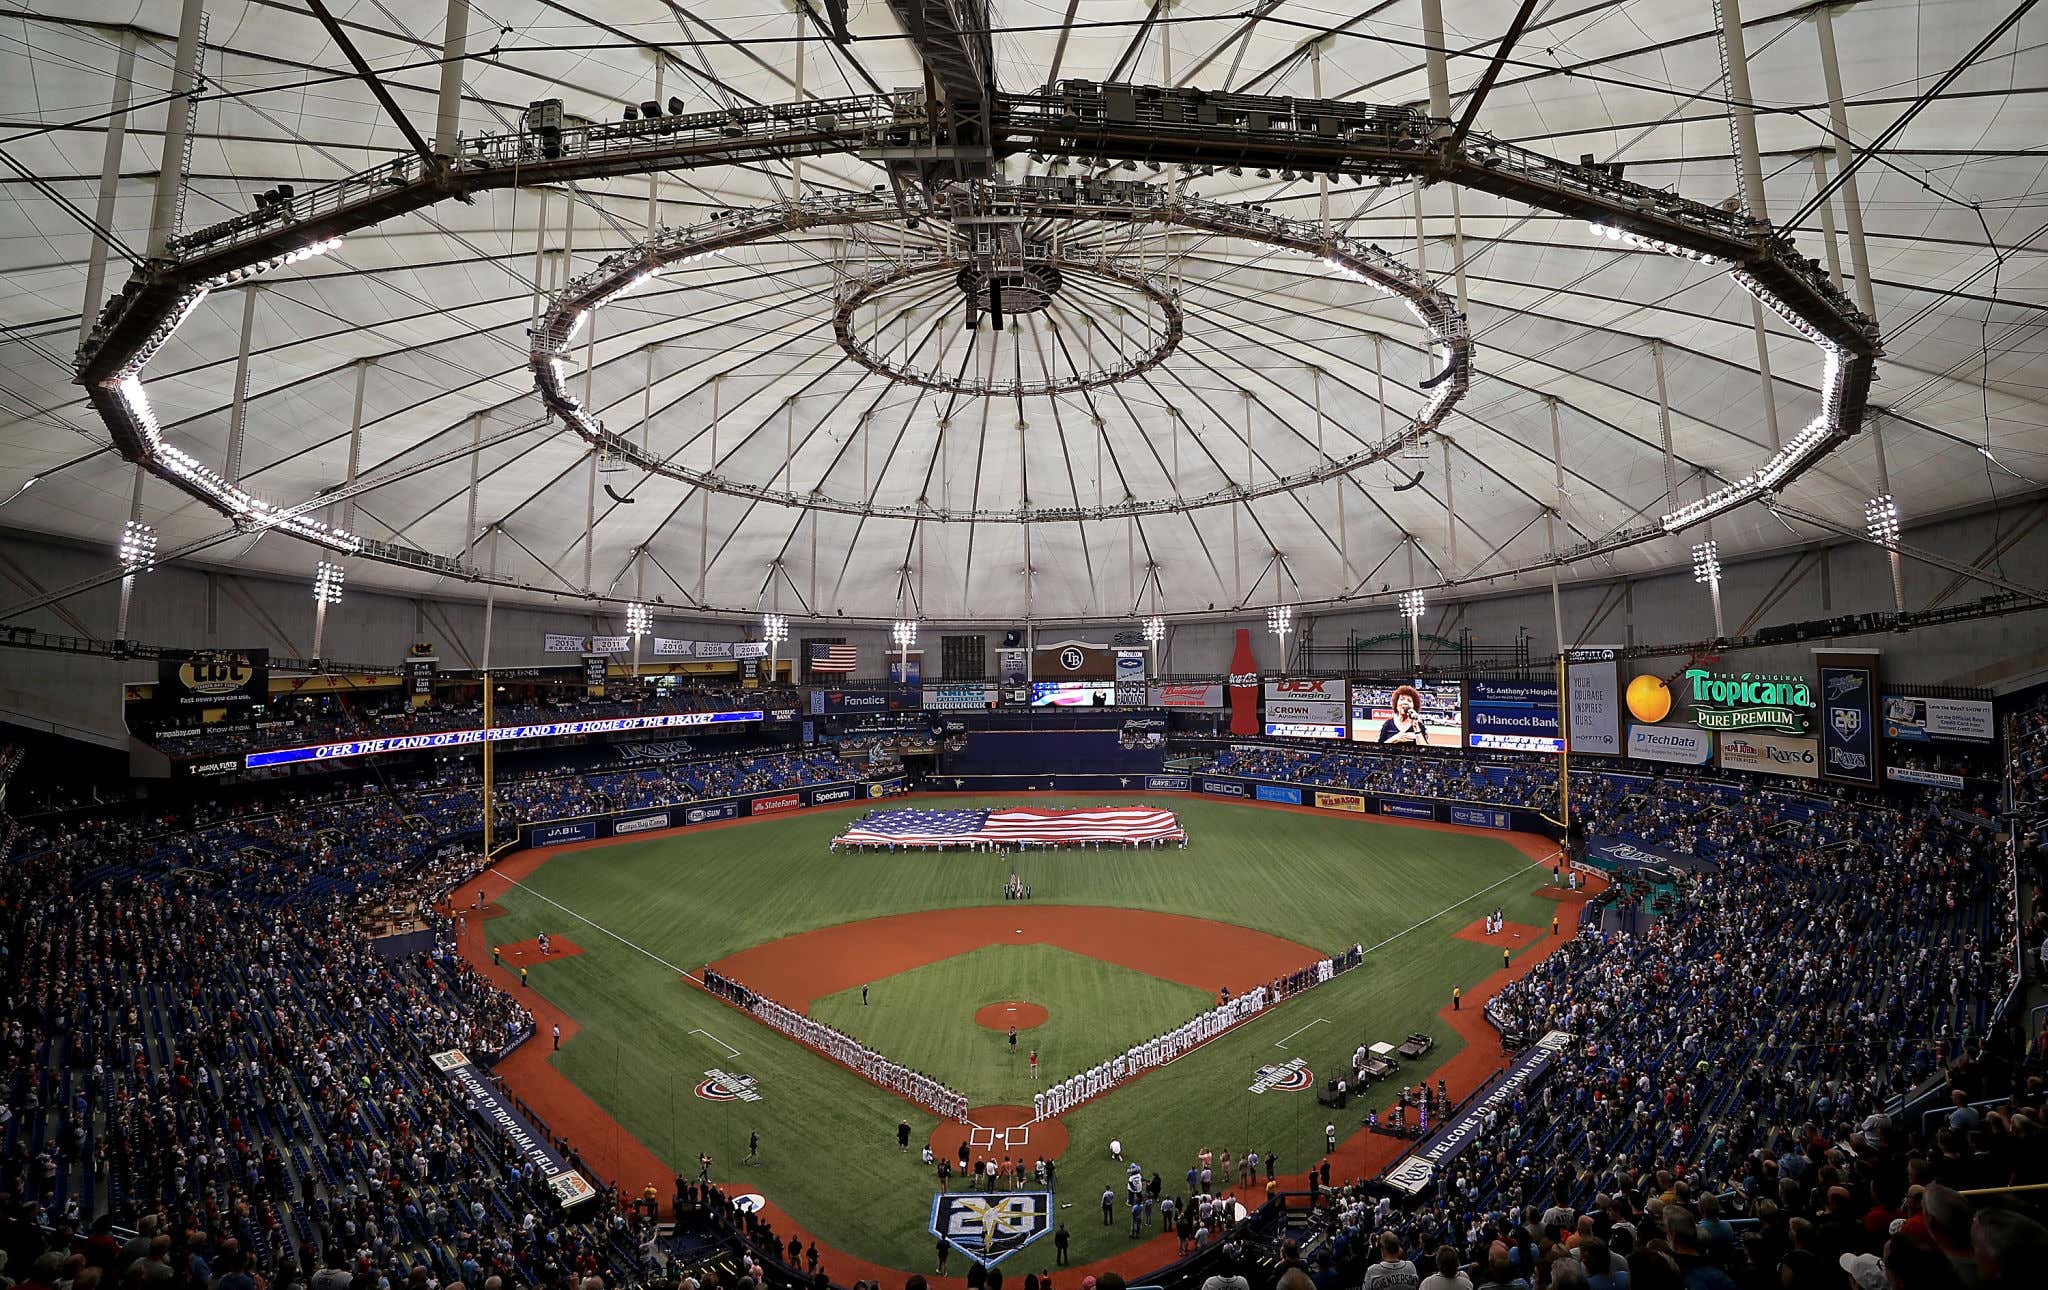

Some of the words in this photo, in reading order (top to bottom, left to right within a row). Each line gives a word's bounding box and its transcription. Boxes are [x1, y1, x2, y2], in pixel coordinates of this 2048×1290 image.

[1064, 651, 1080, 666] TB
[1574, 677, 1590, 688] YOUR
[1754, 674, 1805, 682] ORIGINAL
[1277, 679, 1325, 692] DEX
[1496, 688, 1530, 696] Anthony's
[1530, 688, 1558, 696] Hospital
[1685, 669, 1811, 708] Tropicana
[844, 696, 885, 706] Fanatics
[1574, 690, 1604, 700] COURAGE
[1274, 706, 1309, 714] CROWN
[1574, 703, 1602, 714] INSPIRES
[1488, 714, 1531, 726] Hancock
[1532, 716, 1559, 728] Bank
[1698, 711, 1730, 726] PURE
[1732, 711, 1794, 726] PREMIUM
[1835, 710, 1857, 728] 20
[206, 726, 228, 734] Know
[316, 744, 352, 758] O'ER
[357, 740, 384, 754] THE
[388, 737, 430, 750] LAND
[434, 734, 454, 746] OF
[457, 732, 482, 744] THE
[487, 728, 518, 741] FREE
[520, 726, 551, 738] AND
[554, 723, 578, 735] THE
[582, 720, 620, 733] HOME
[623, 719, 641, 729] OF
[642, 718, 665, 728] THE
[667, 714, 715, 726] BRAVE?
[1802, 750, 1814, 764] 6
[1204, 782, 1242, 794] GEICO
[816, 790, 849, 802] Spectrum
[706, 808, 720, 818] SUN
[618, 821, 637, 832] Tampa
[638, 820, 650, 831] Bay
[650, 817, 667, 828] Times
[548, 826, 581, 837] JABIL
[1248, 1066, 1294, 1094] OPENING
[1284, 1057, 1308, 1072] DAY
[704, 1068, 746, 1092] OPENING
[736, 1090, 763, 1102] DAY
[1426, 1116, 1478, 1162] WELCOME
[1472, 1106, 1490, 1120] TO
[1484, 1068, 1532, 1110] TROPICANA
[1526, 1048, 1552, 1070] FIELD
[454, 1066, 487, 1098] WELCOME
[482, 1097, 498, 1109] TO
[490, 1106, 536, 1152] TROPICANA
[528, 1149, 560, 1176] FIELD
[947, 1196, 1036, 1235] 20
